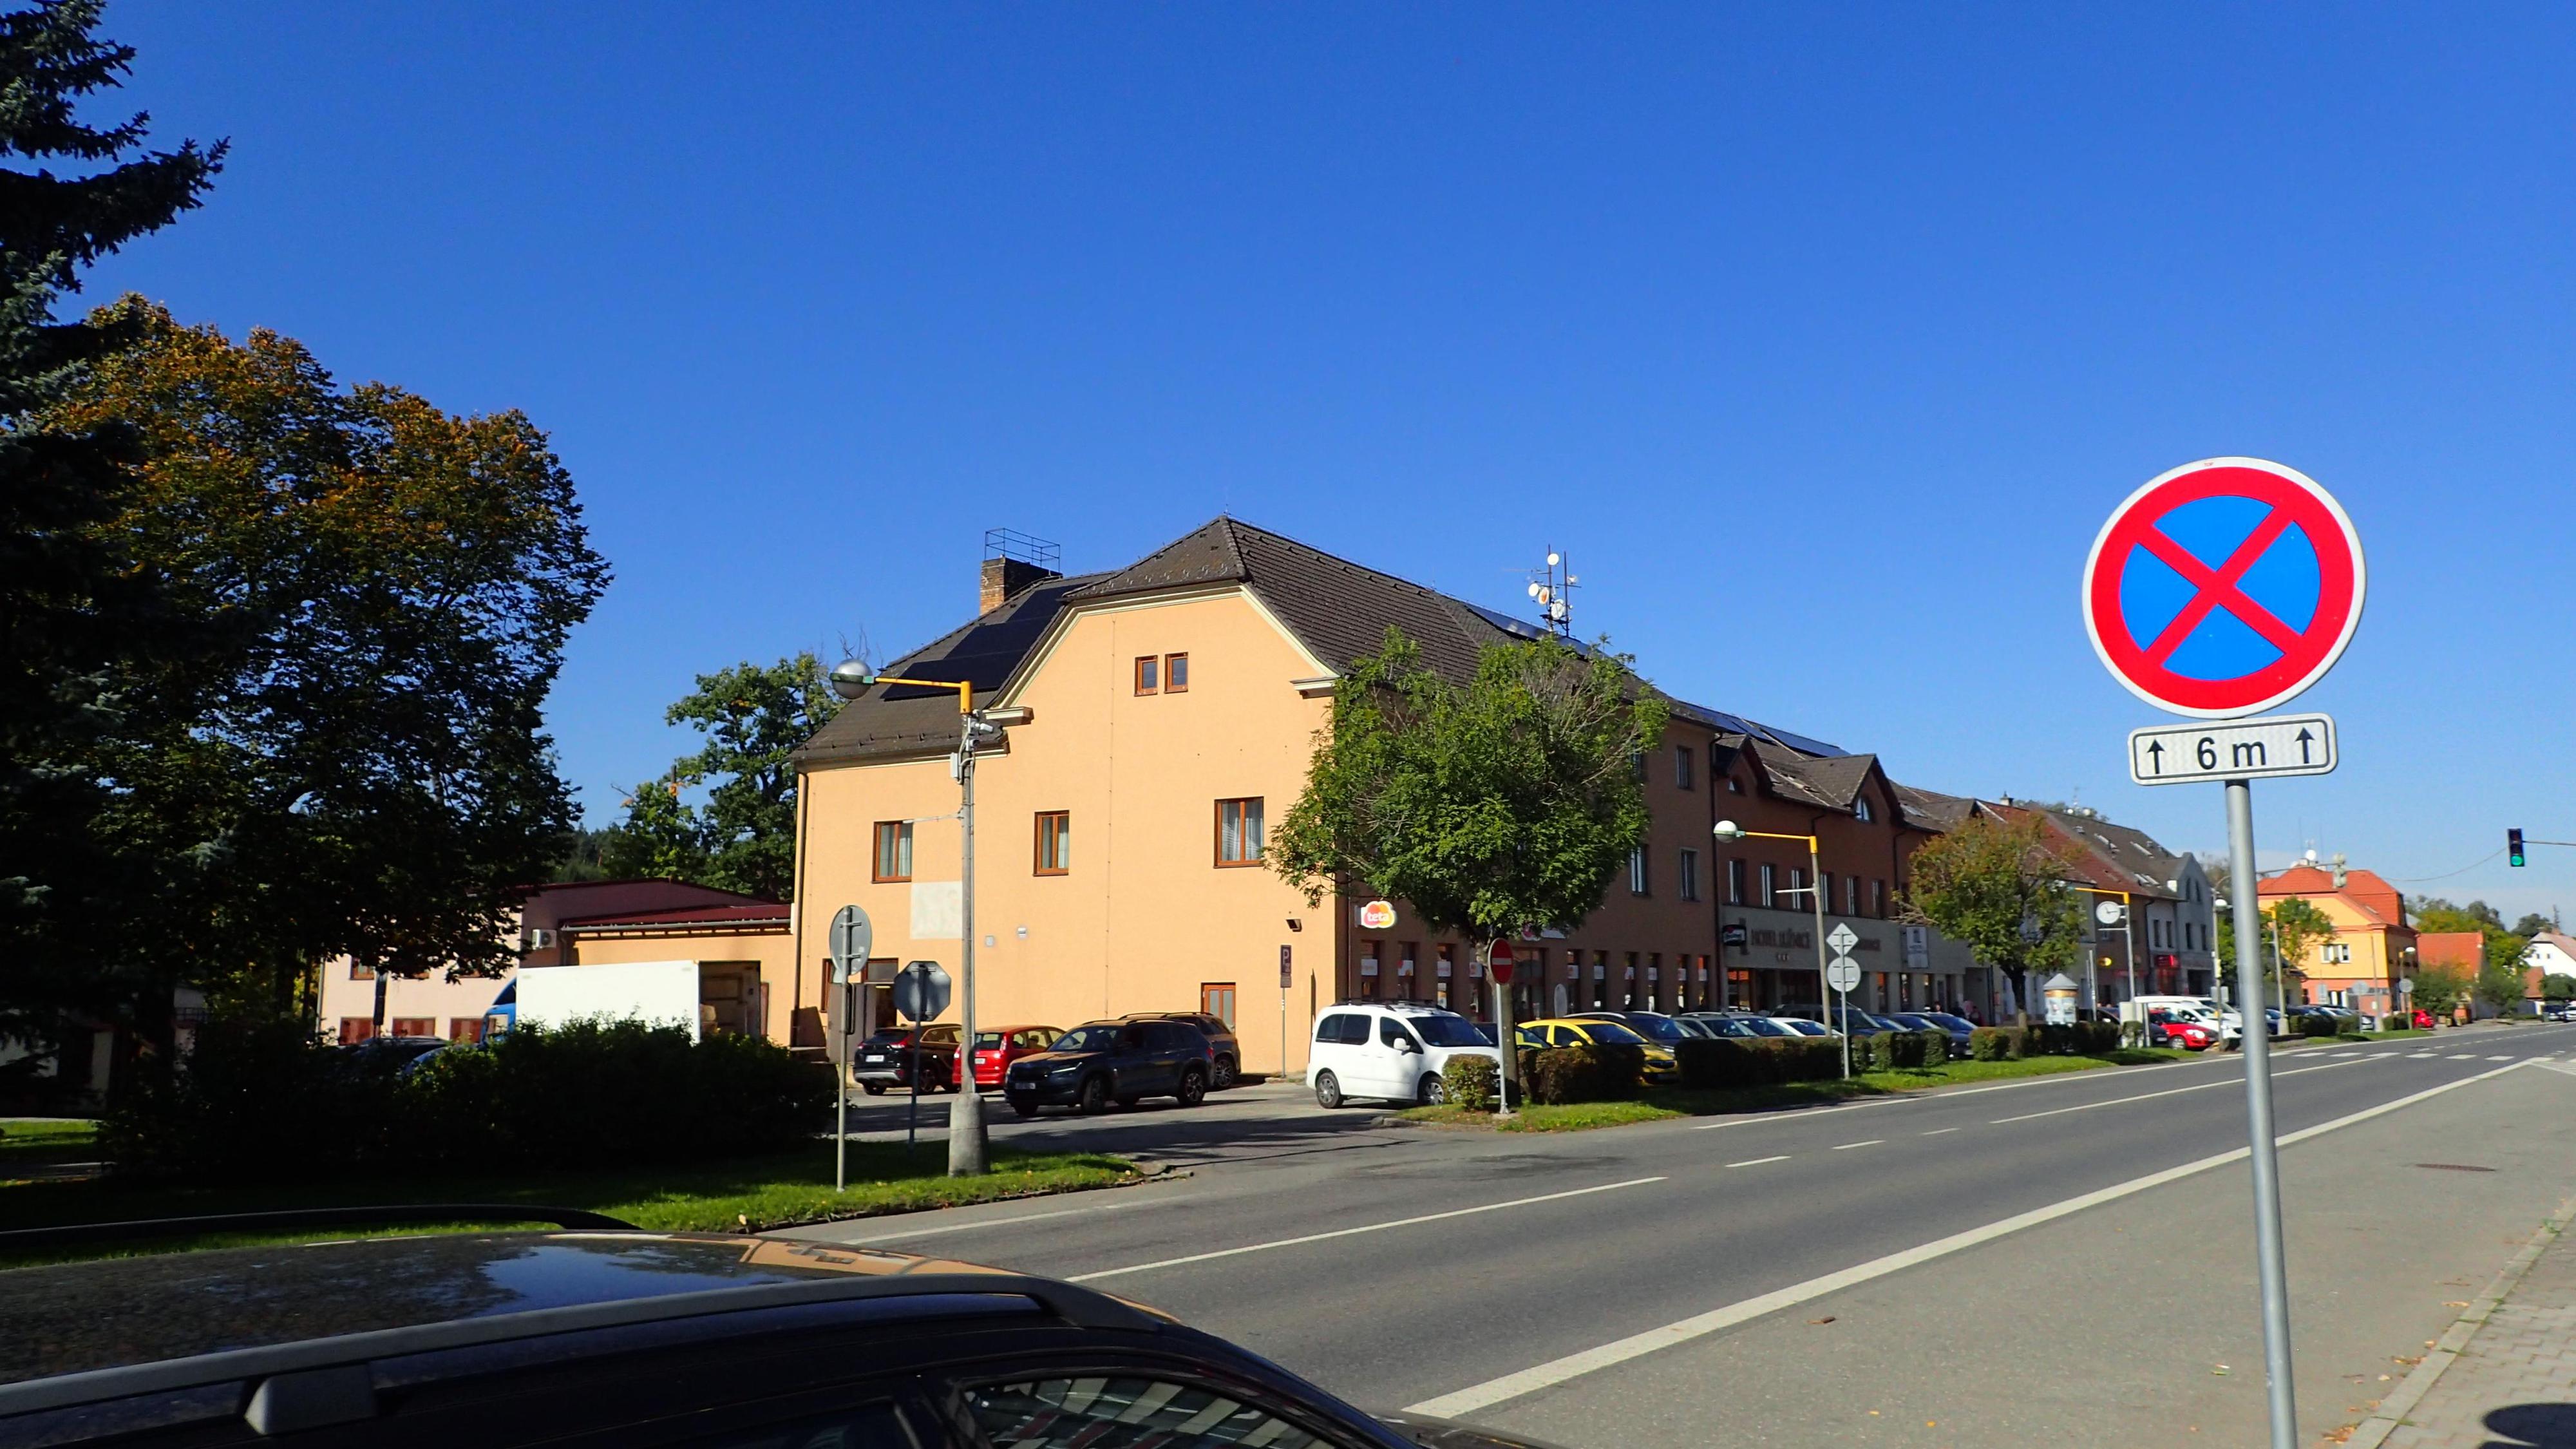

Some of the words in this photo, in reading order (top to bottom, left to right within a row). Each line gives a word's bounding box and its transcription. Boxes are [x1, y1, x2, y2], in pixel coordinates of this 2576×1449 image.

[2197, 737, 2217, 770] 6
[2231, 740, 2266, 767] m
[1367, 912, 1389, 922] teta
[1282, 949, 1290, 966] P
